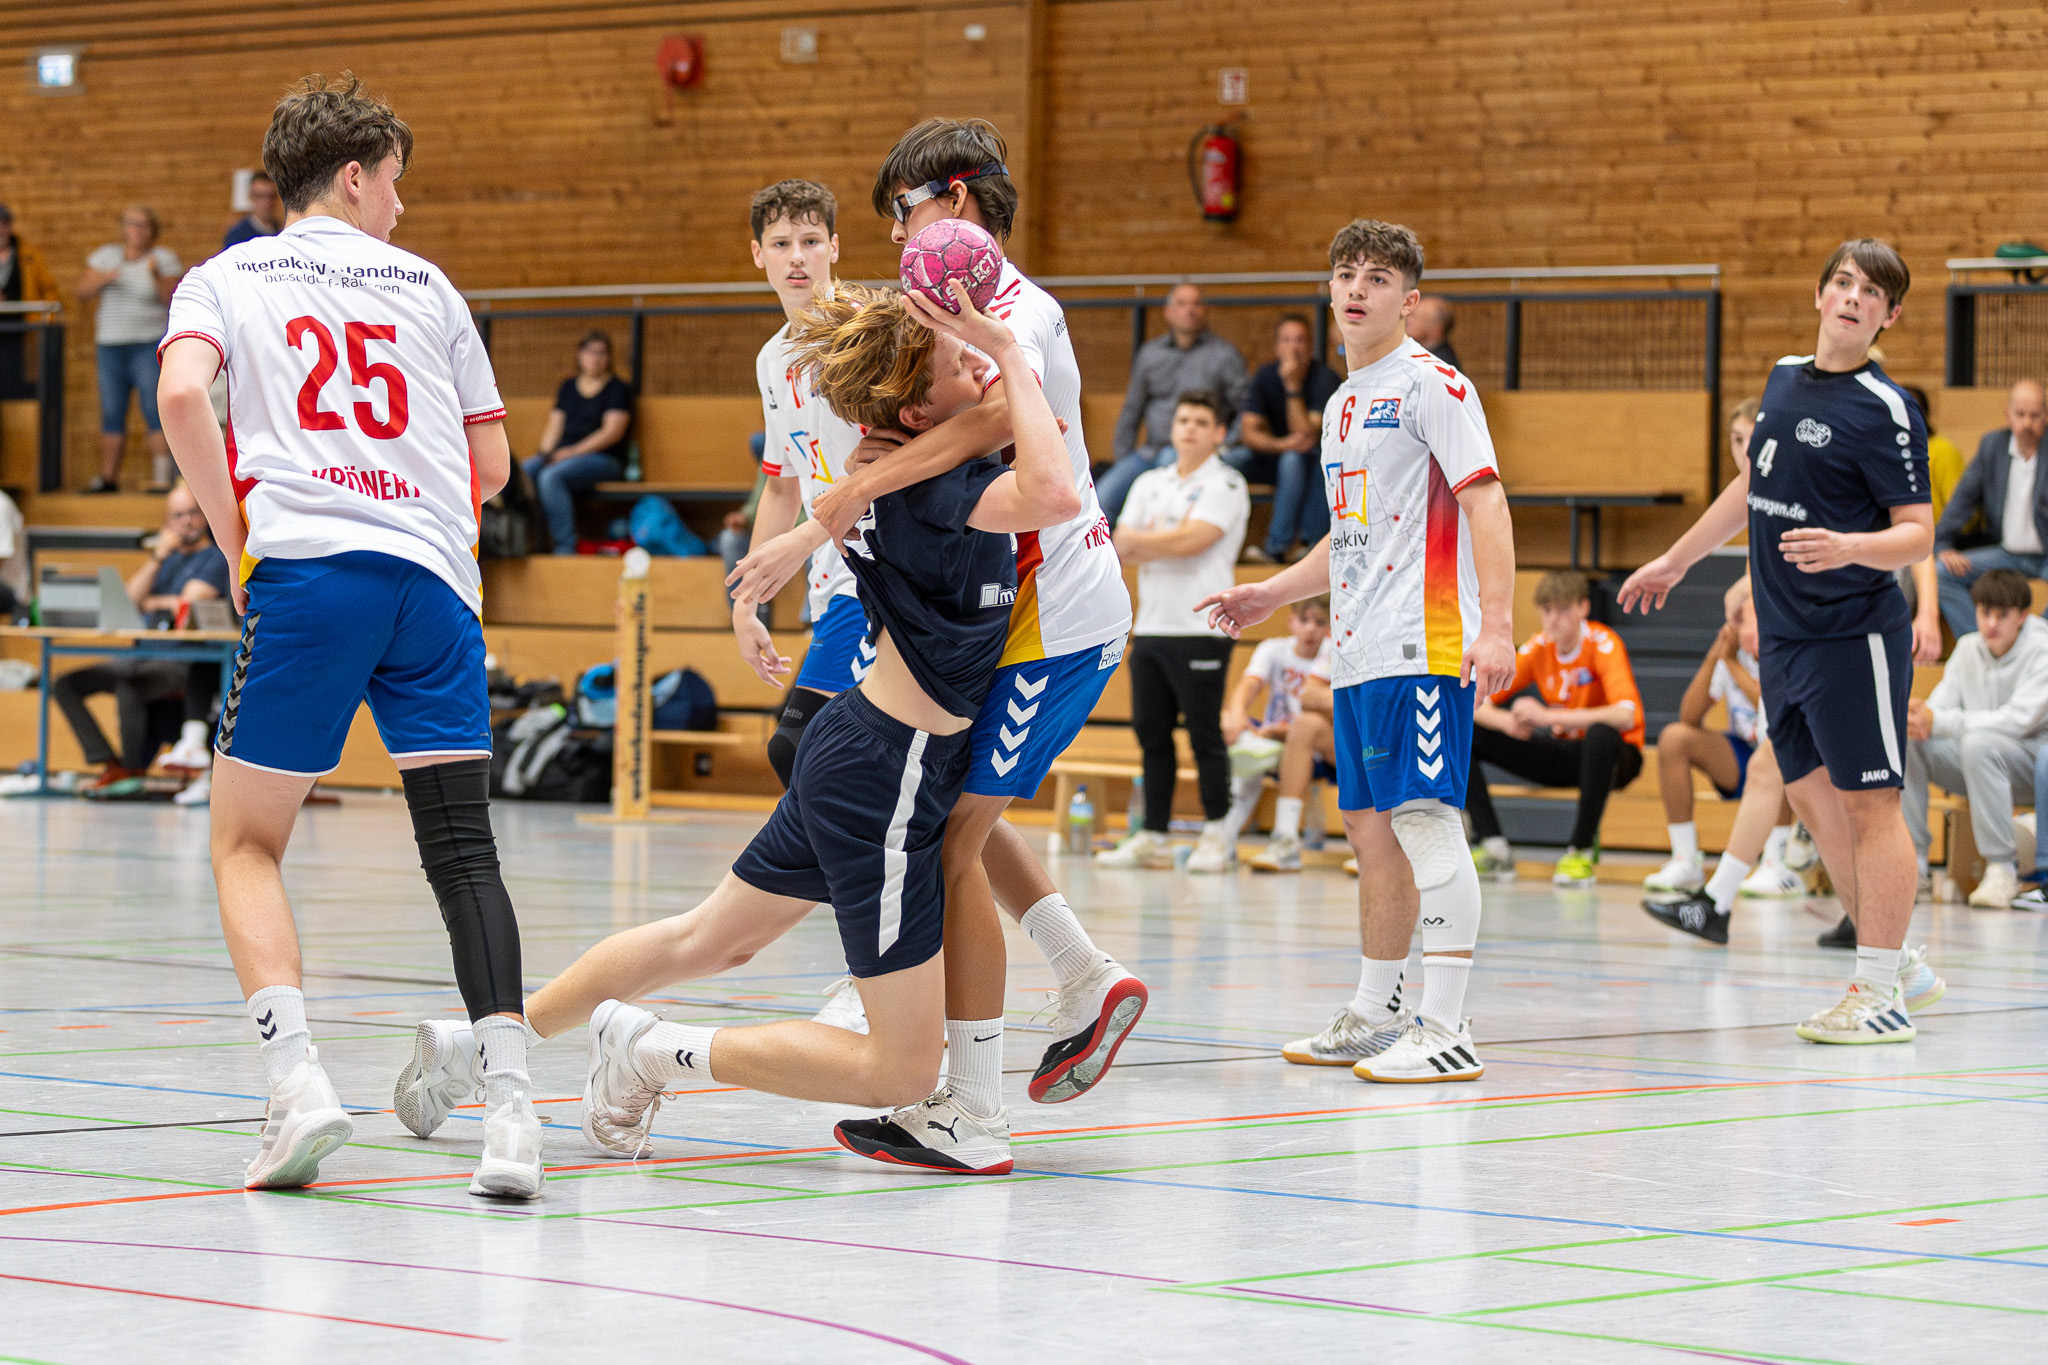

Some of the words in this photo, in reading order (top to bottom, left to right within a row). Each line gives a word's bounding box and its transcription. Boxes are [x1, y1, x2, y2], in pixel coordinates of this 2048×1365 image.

[945, 251, 997, 301] SLECT
[285, 315, 410, 441] 25
[1339, 395, 1356, 443] 6
[1756, 437, 1779, 478] 4
[1860, 768, 1890, 784] JAKO
